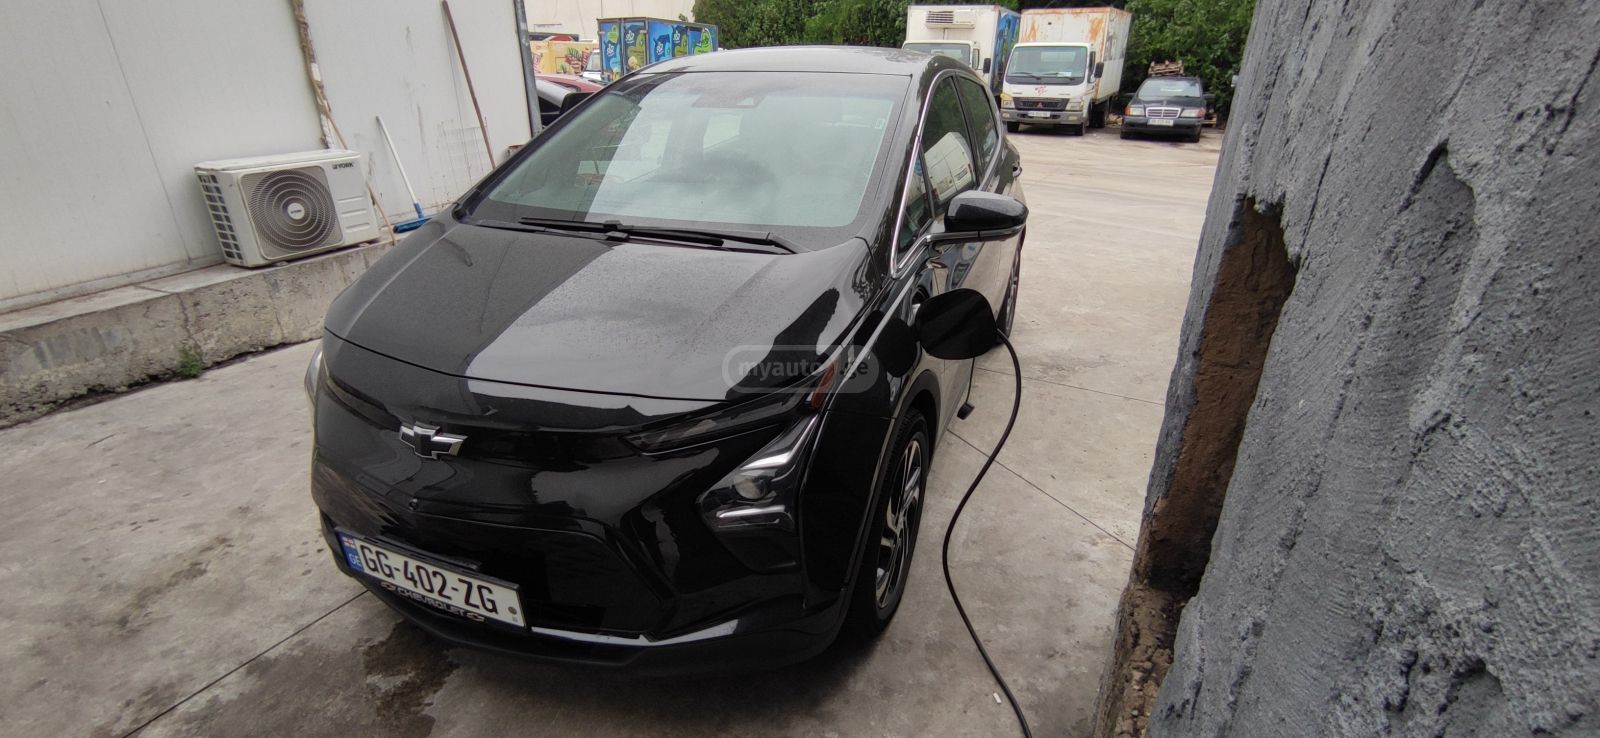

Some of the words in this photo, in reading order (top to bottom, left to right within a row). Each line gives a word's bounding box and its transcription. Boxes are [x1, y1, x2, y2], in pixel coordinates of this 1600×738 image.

[349, 553, 362, 566] GE
[359, 544, 498, 614] GG-402-ZG
[397, 587, 465, 616] CHEVROLET
